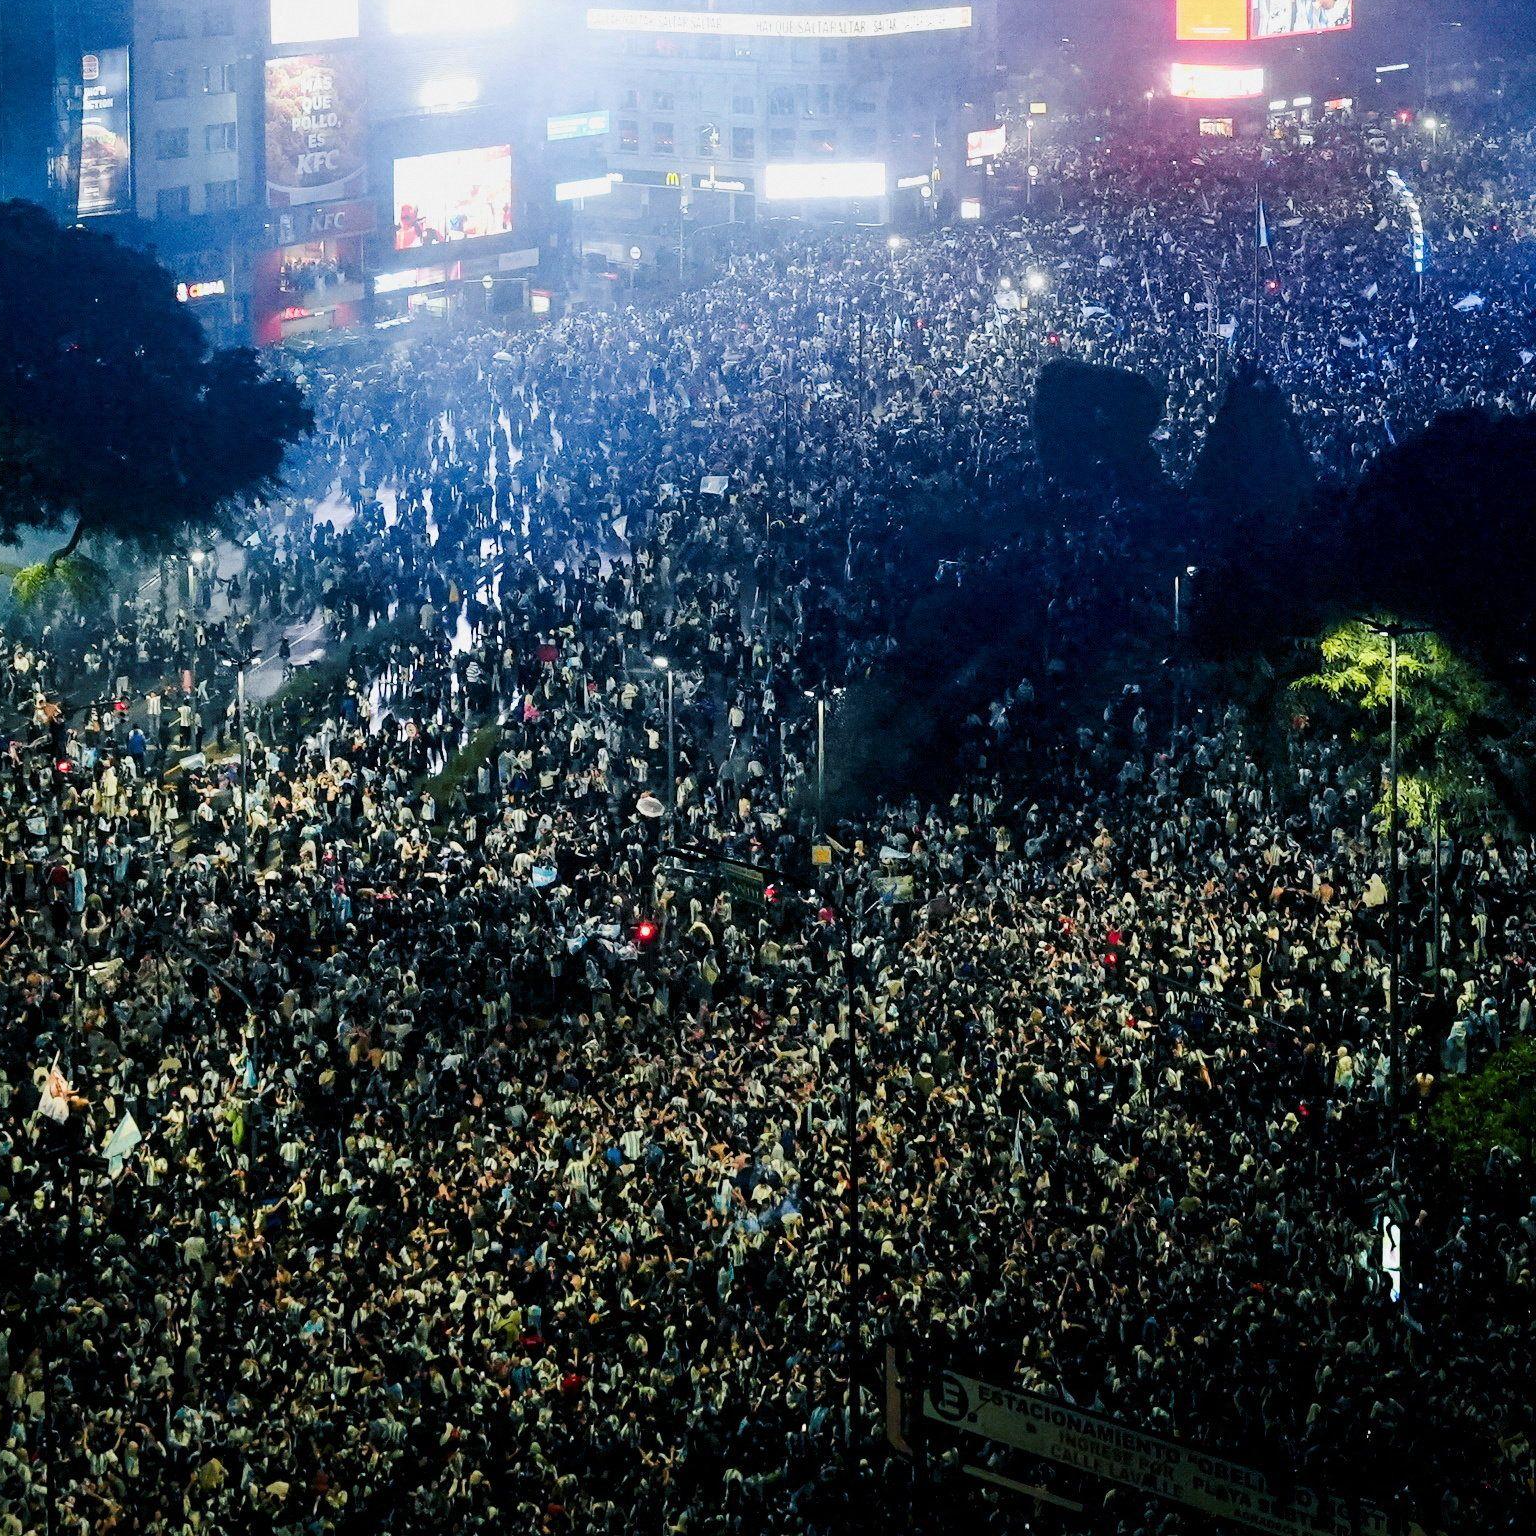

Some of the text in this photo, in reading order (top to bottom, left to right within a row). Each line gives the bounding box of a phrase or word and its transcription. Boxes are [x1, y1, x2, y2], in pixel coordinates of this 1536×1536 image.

[301, 96, 332, 112] QUE
[308, 134, 326, 149] ES
[297, 150, 340, 175] KFC
[310, 211, 345, 231] KFC
[979, 1383, 1180, 1465] ESTACIONAMIENTO
